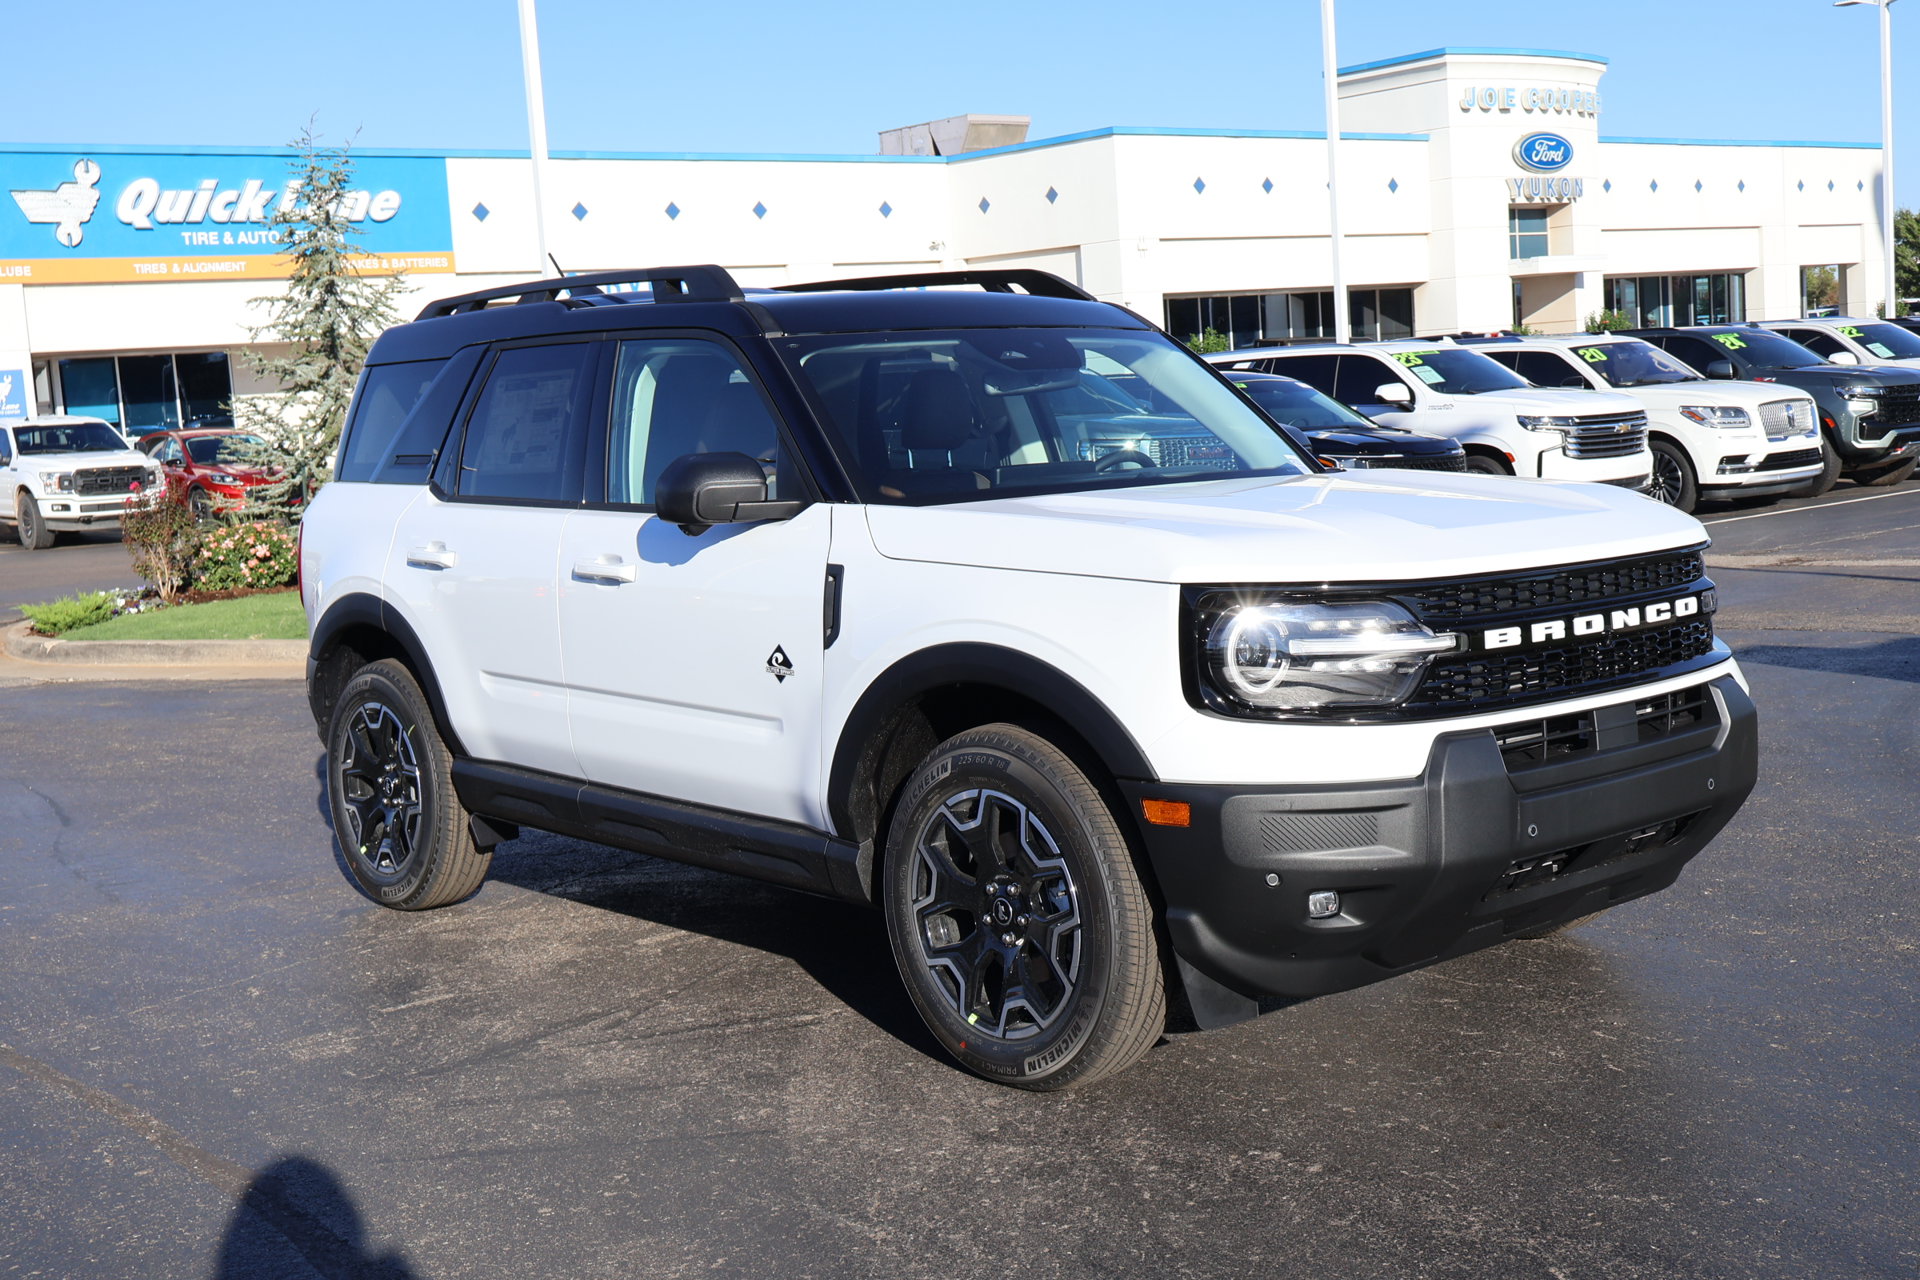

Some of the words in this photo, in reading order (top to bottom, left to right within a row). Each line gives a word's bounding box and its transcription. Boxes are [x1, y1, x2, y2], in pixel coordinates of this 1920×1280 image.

[1462, 87, 1516, 110] JOE
[1531, 139, 1564, 162] Ford
[1510, 177, 1583, 199] YUKON
[115, 177, 276, 231] Quick
[181, 232, 219, 245] TIRE
[222, 231, 234, 244] &
[237, 231, 280, 244] AUTO
[0, 265, 32, 276] LUBE
[133, 263, 168, 274] TIRES
[172, 262, 180, 273] &
[182, 261, 247, 273] ALIGNMENT
[381, 259, 389, 269] &
[391, 257, 449, 269] BATTERIES
[1837, 326, 1865, 338] 22
[1578, 348, 1608, 362] 20
[1484, 596, 1698, 650] BRONCO
[958, 755, 986, 765] 225/60
[996, 760, 1005, 769] 18
[902, 760, 949, 818] MICHELIN
[1026, 1020, 1083, 1073] MICHELIN
